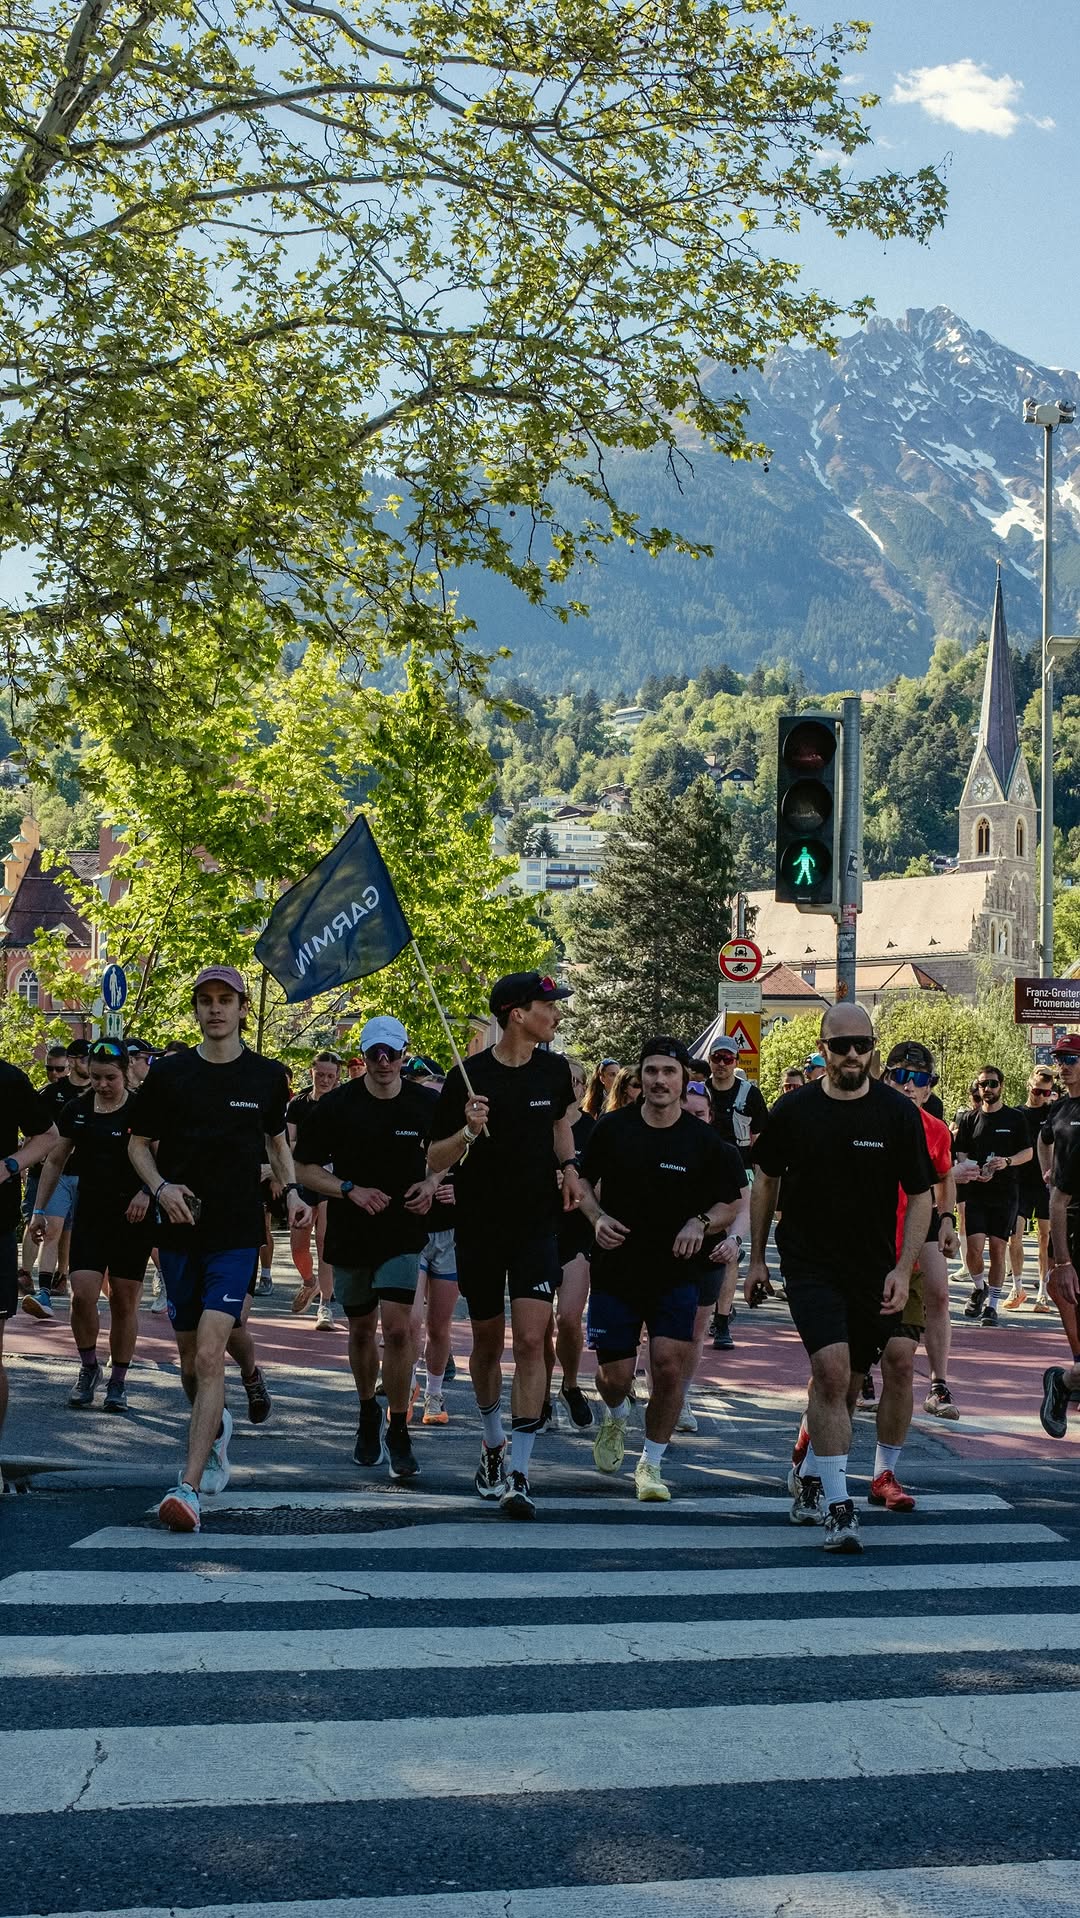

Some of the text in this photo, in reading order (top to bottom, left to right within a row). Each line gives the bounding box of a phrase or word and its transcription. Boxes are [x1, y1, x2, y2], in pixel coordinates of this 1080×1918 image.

[1033, 998, 1080, 1009] Promenade
[229, 1100, 259, 1109] GARMIN
[852, 1140, 884, 1148] GARMIN
[659, 1162, 687, 1172] GARMIN
